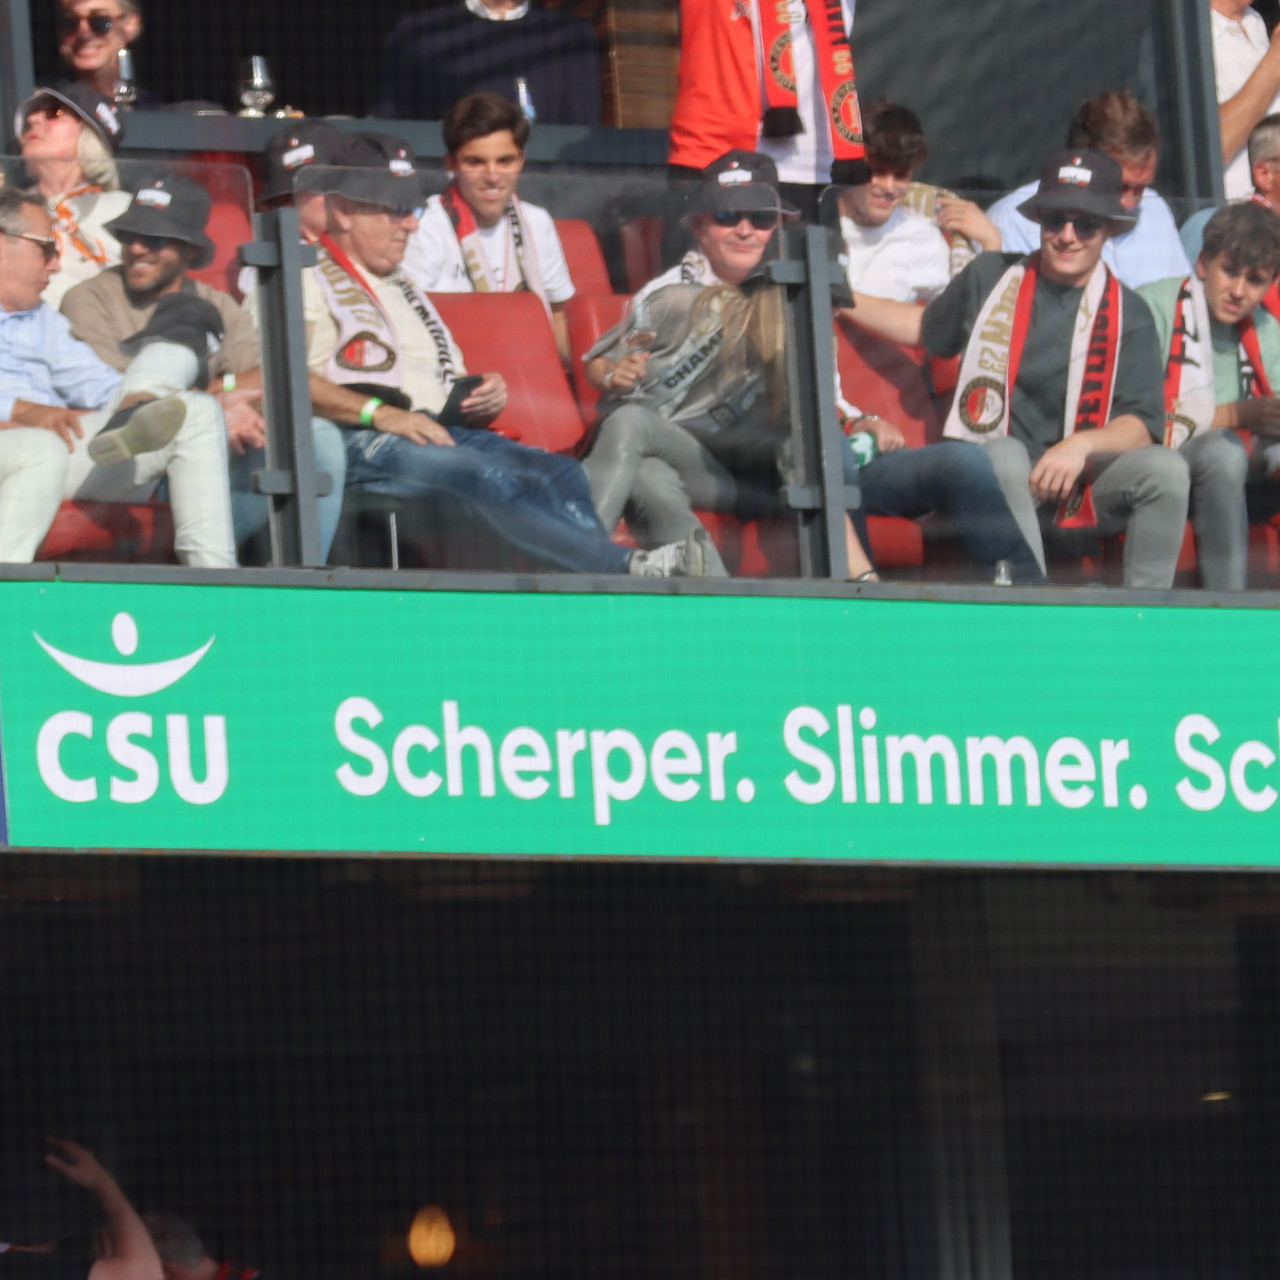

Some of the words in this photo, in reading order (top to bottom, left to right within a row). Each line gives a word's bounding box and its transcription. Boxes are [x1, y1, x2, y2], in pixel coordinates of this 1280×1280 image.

[35, 709, 230, 806] CSU
[333, 695, 757, 827] Scherper.
[782, 703, 1149, 811] Slimmer.
